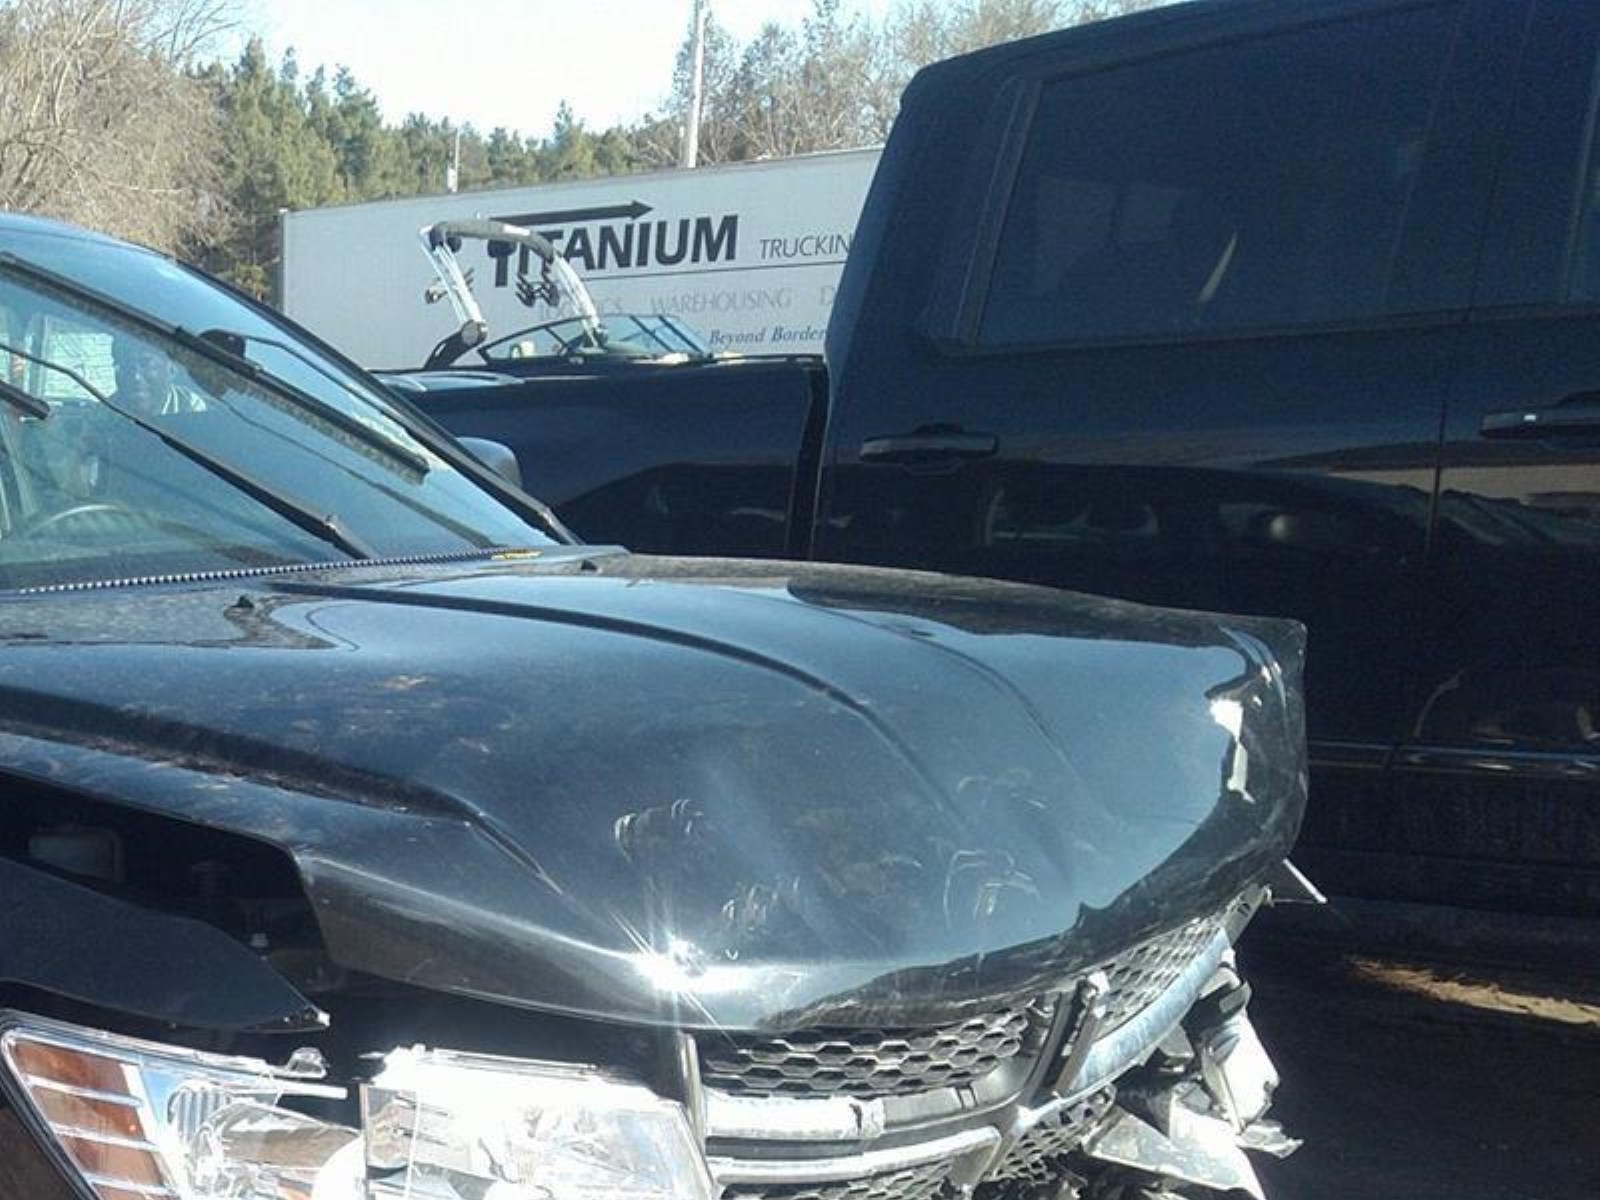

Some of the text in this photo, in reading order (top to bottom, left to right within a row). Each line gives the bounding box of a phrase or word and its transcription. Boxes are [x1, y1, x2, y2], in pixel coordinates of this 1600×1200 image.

[495, 214, 852, 287] TITANIUM TRUCKIN
[652, 286, 792, 317] WAREHOUSING
[709, 325, 827, 352] Beyond Border
